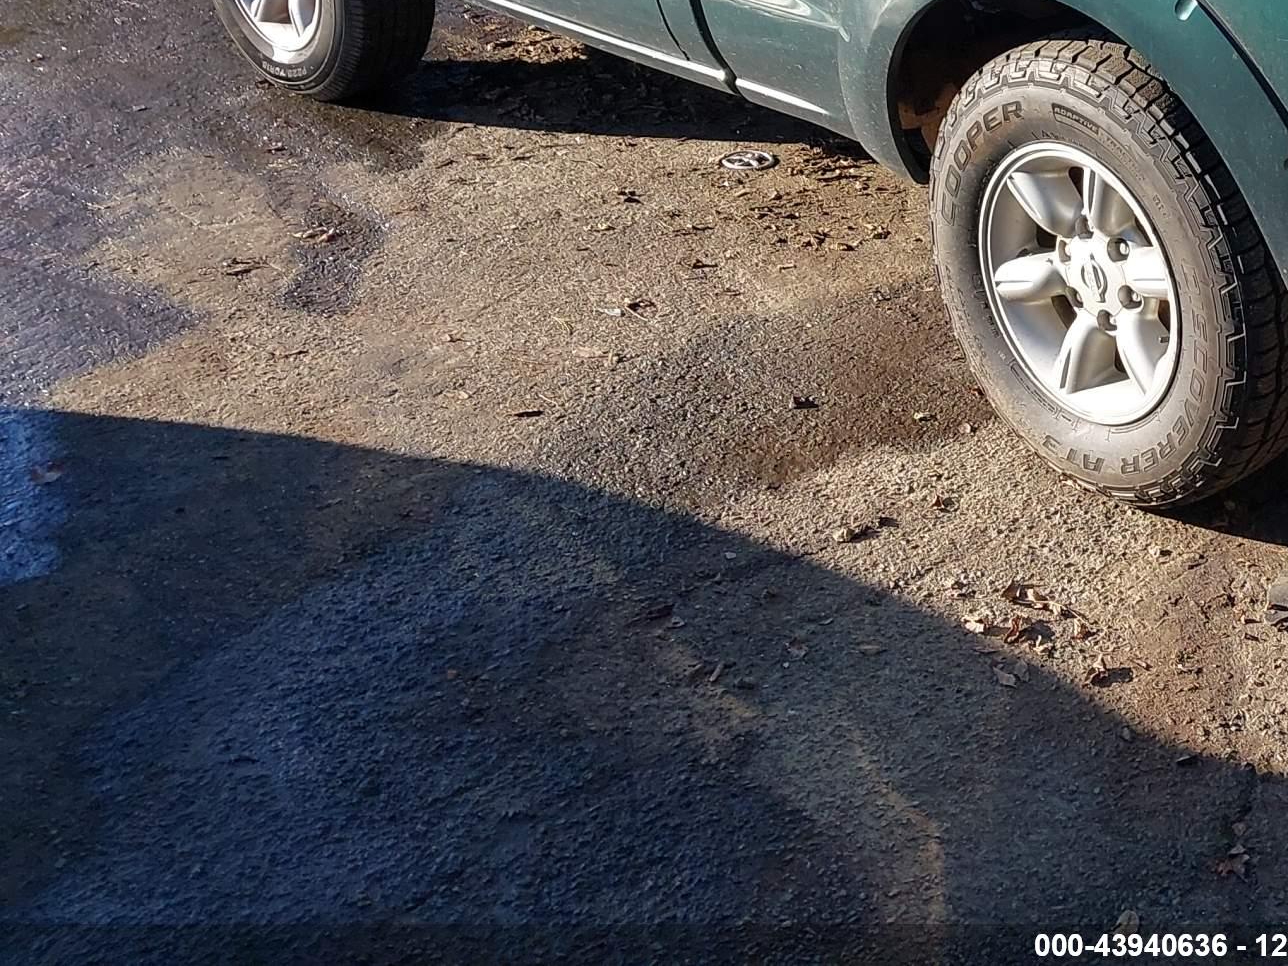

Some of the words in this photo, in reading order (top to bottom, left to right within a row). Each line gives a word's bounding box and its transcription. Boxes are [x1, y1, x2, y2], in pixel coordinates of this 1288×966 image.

[940, 100, 1025, 226] COOPER
[1054, 106, 1099, 134] ADAPTIVE
[1120, 258, 1208, 475] DISCOVERER
